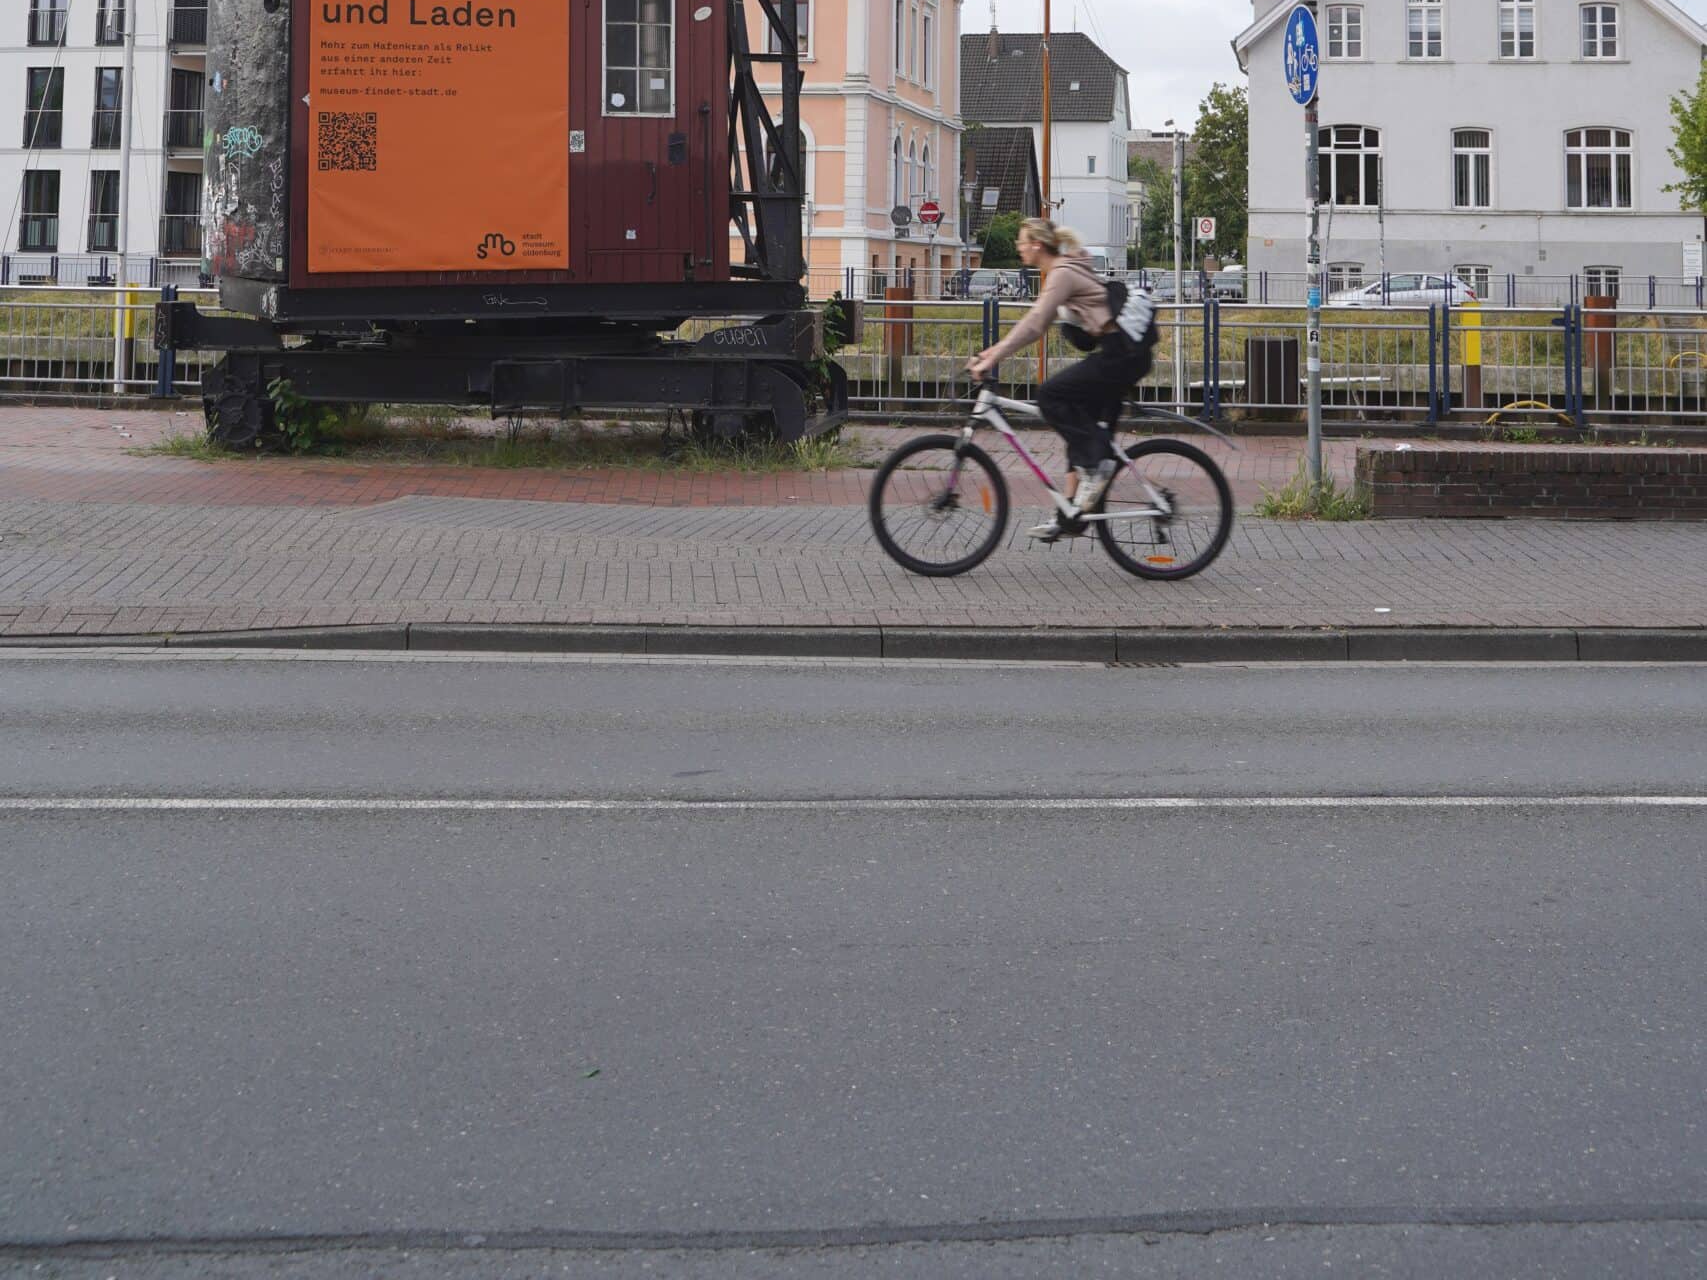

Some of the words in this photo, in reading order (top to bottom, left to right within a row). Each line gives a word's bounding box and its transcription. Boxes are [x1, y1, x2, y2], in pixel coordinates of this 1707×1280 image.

[409, 0, 517, 28] Laden
[320, 40, 346, 50] Mehr
[351, 42, 370, 50] zum
[373, 41, 430, 51] Hafenkran
[433, 42, 452, 52] als
[455, 43, 493, 52] Relikt
[320, 55, 340, 63] aus
[344, 54, 375, 64] einer
[379, 54, 424, 64] anderen
[426, 55, 453, 65] Zeit
[320, 67, 365, 76] erfahrt
[369, 68, 388, 77] ihr
[392, 68, 423, 77] hier:
[319, 86, 458, 97] museum-findet-stadt.de
[522, 249, 562, 258] oldenburg
